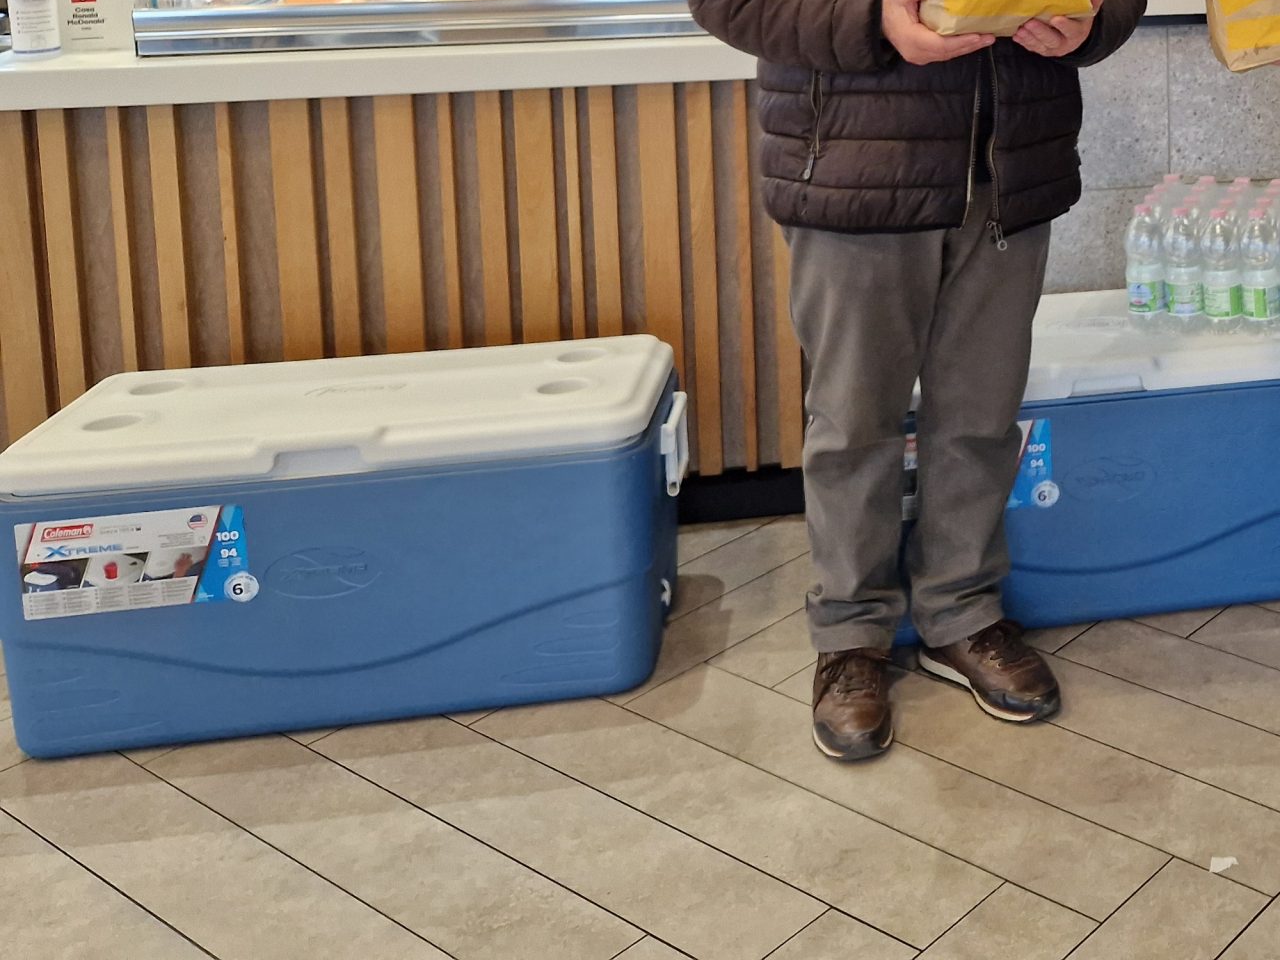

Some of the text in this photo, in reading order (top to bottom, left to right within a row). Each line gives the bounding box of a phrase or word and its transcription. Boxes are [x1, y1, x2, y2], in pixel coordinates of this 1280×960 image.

[1027, 443, 1046, 453] 100
[1031, 459, 1044, 468] 94
[44, 527, 83, 539] Coleman
[216, 531, 240, 541] 100
[44, 544, 124, 560] XTREME
[220, 548, 238, 558] 94
[232, 583, 244, 596] 6
